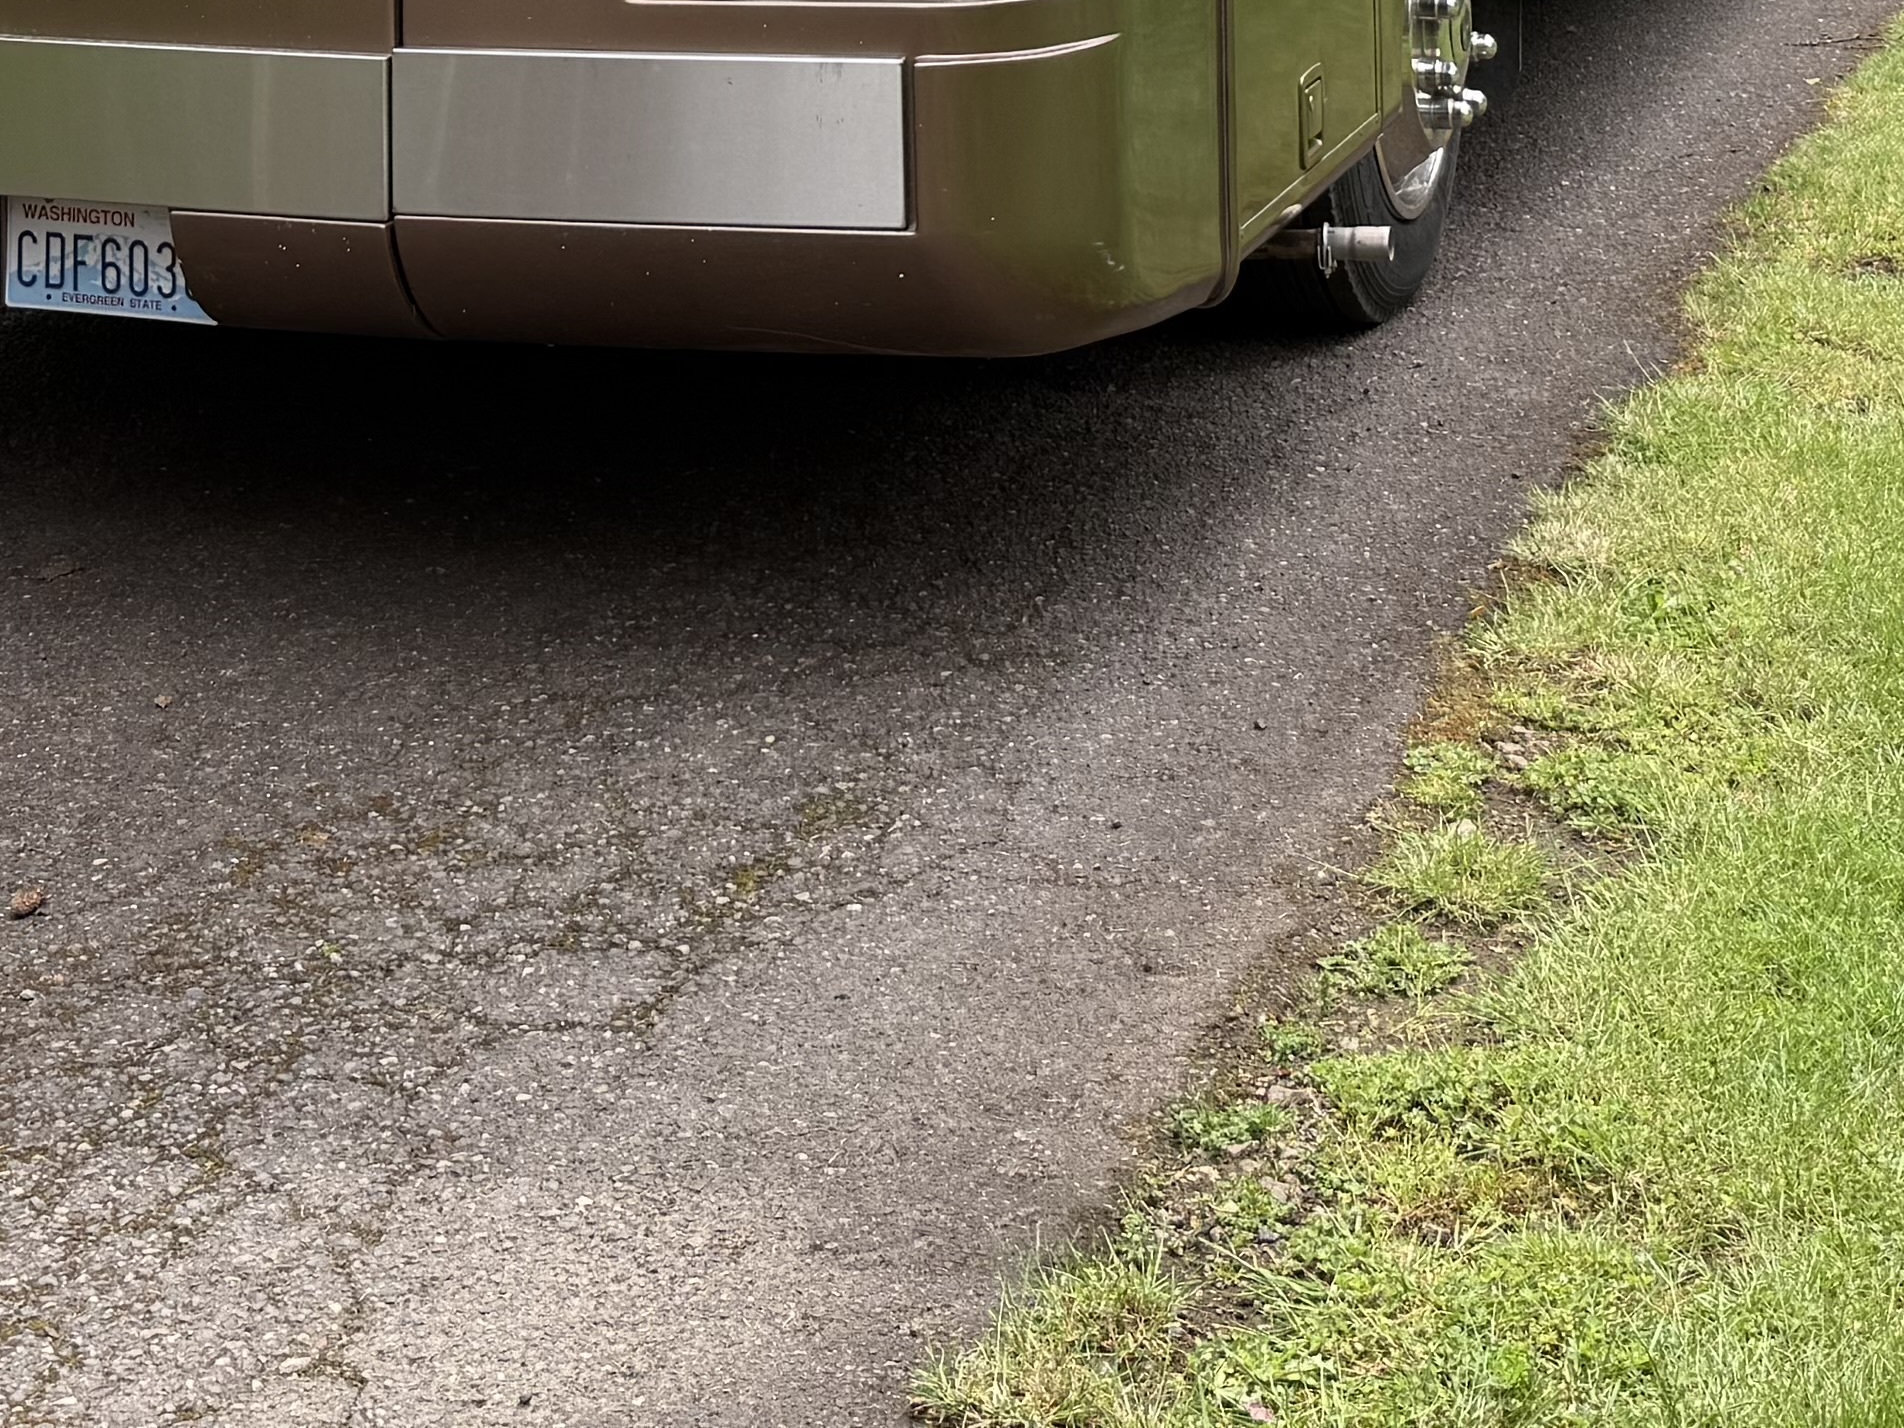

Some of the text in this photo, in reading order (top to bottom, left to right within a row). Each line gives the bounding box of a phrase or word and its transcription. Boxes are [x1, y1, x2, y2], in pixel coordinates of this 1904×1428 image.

[22, 203, 136, 228] WASHINGTON
[17, 229, 194, 300] CDF603
[62, 292, 162, 311] EVERGREEN STATE
